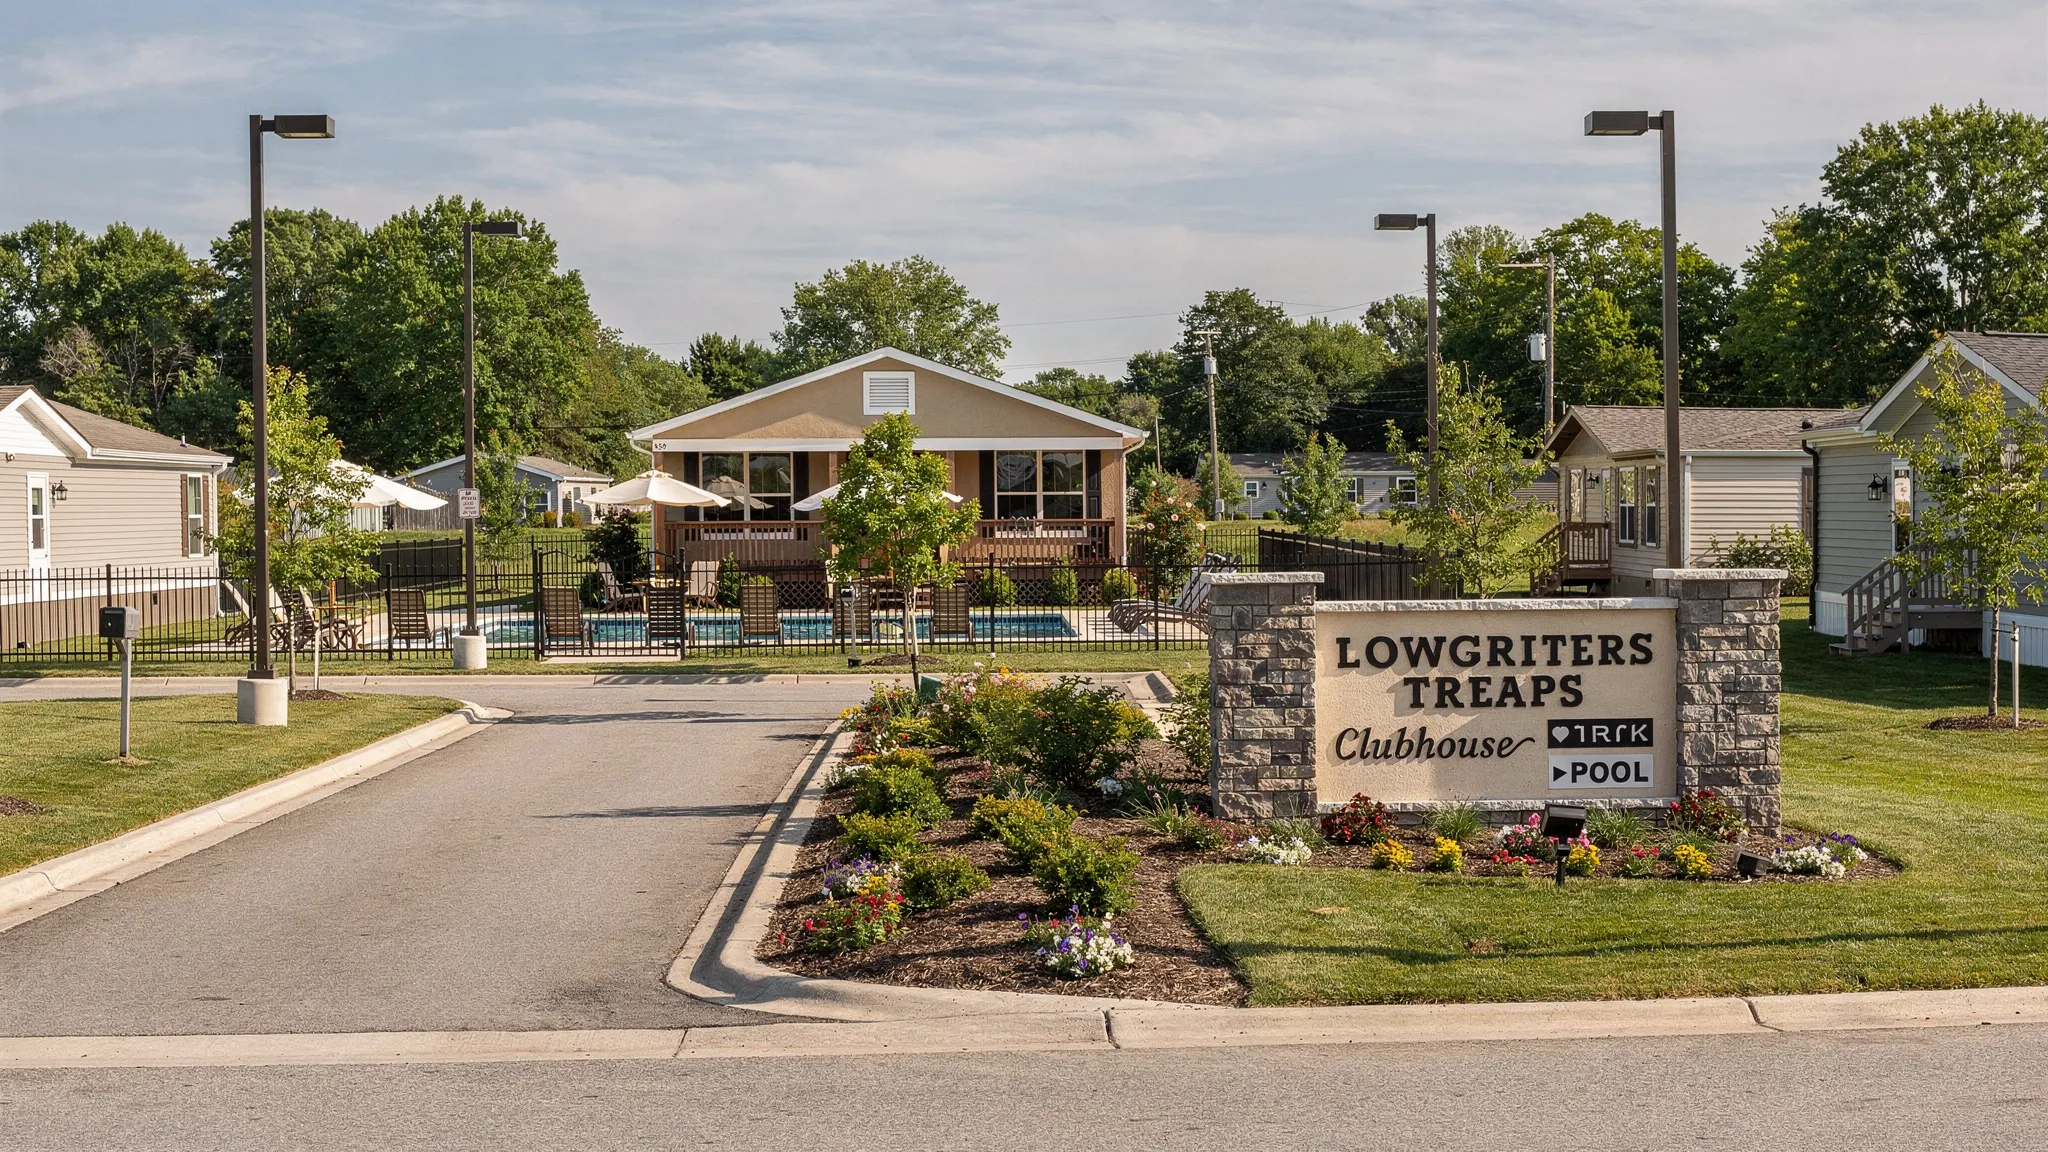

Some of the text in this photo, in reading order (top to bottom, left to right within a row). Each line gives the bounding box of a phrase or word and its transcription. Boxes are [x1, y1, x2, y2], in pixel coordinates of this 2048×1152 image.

[1336, 633, 1653, 668] LOWGRITERS
[1404, 674, 1583, 708] TREAPS
[1335, 727, 1535, 760] Clubhouse
[1571, 761, 1649, 783] POOL
